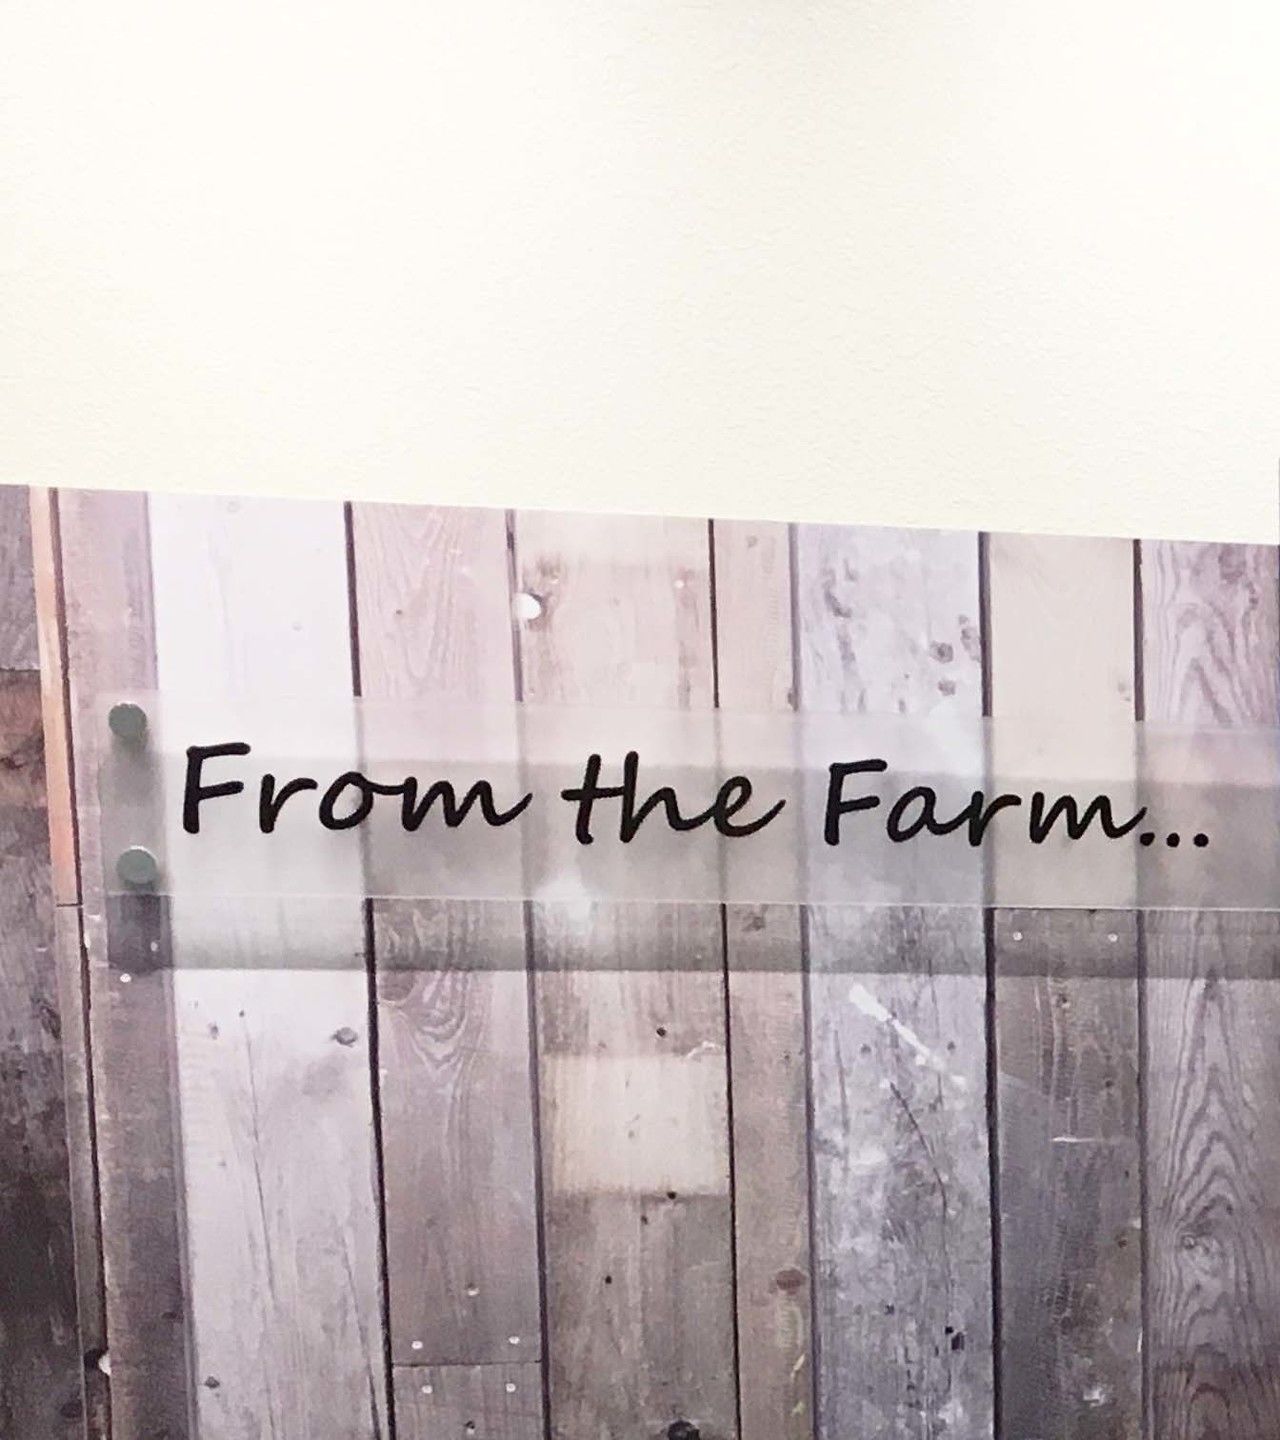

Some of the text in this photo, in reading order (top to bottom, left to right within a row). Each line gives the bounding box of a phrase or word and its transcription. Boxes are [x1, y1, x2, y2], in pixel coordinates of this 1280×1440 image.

[183, 742, 1209, 847] From the Farm...
